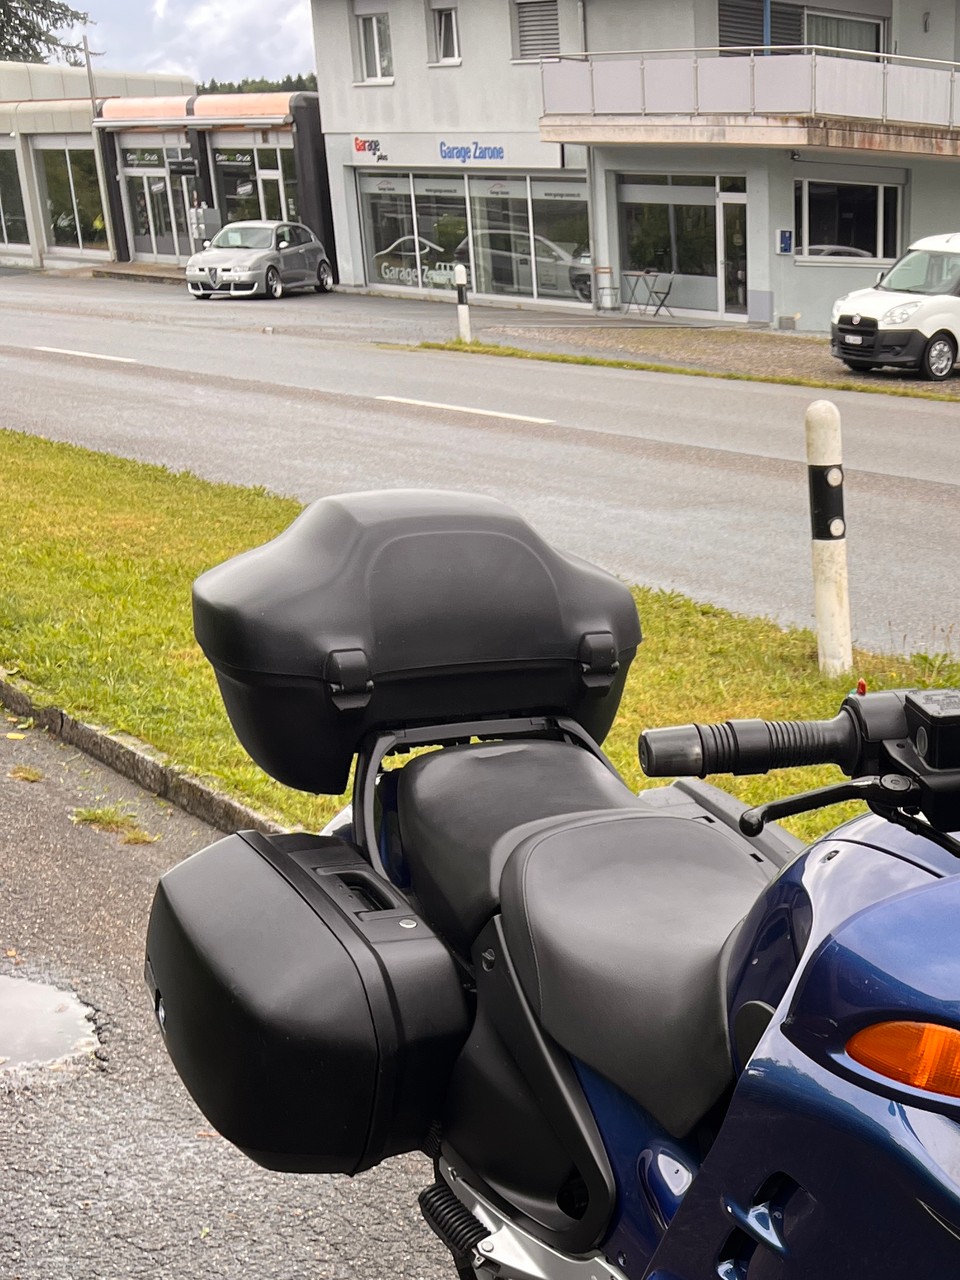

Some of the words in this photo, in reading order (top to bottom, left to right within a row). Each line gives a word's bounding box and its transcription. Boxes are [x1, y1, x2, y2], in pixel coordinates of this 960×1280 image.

[354, 137, 381, 156] Garage
[440, 141, 471, 163] Garage
[472, 141, 504, 160] Zarone
[381, 262, 418, 284] Garage
